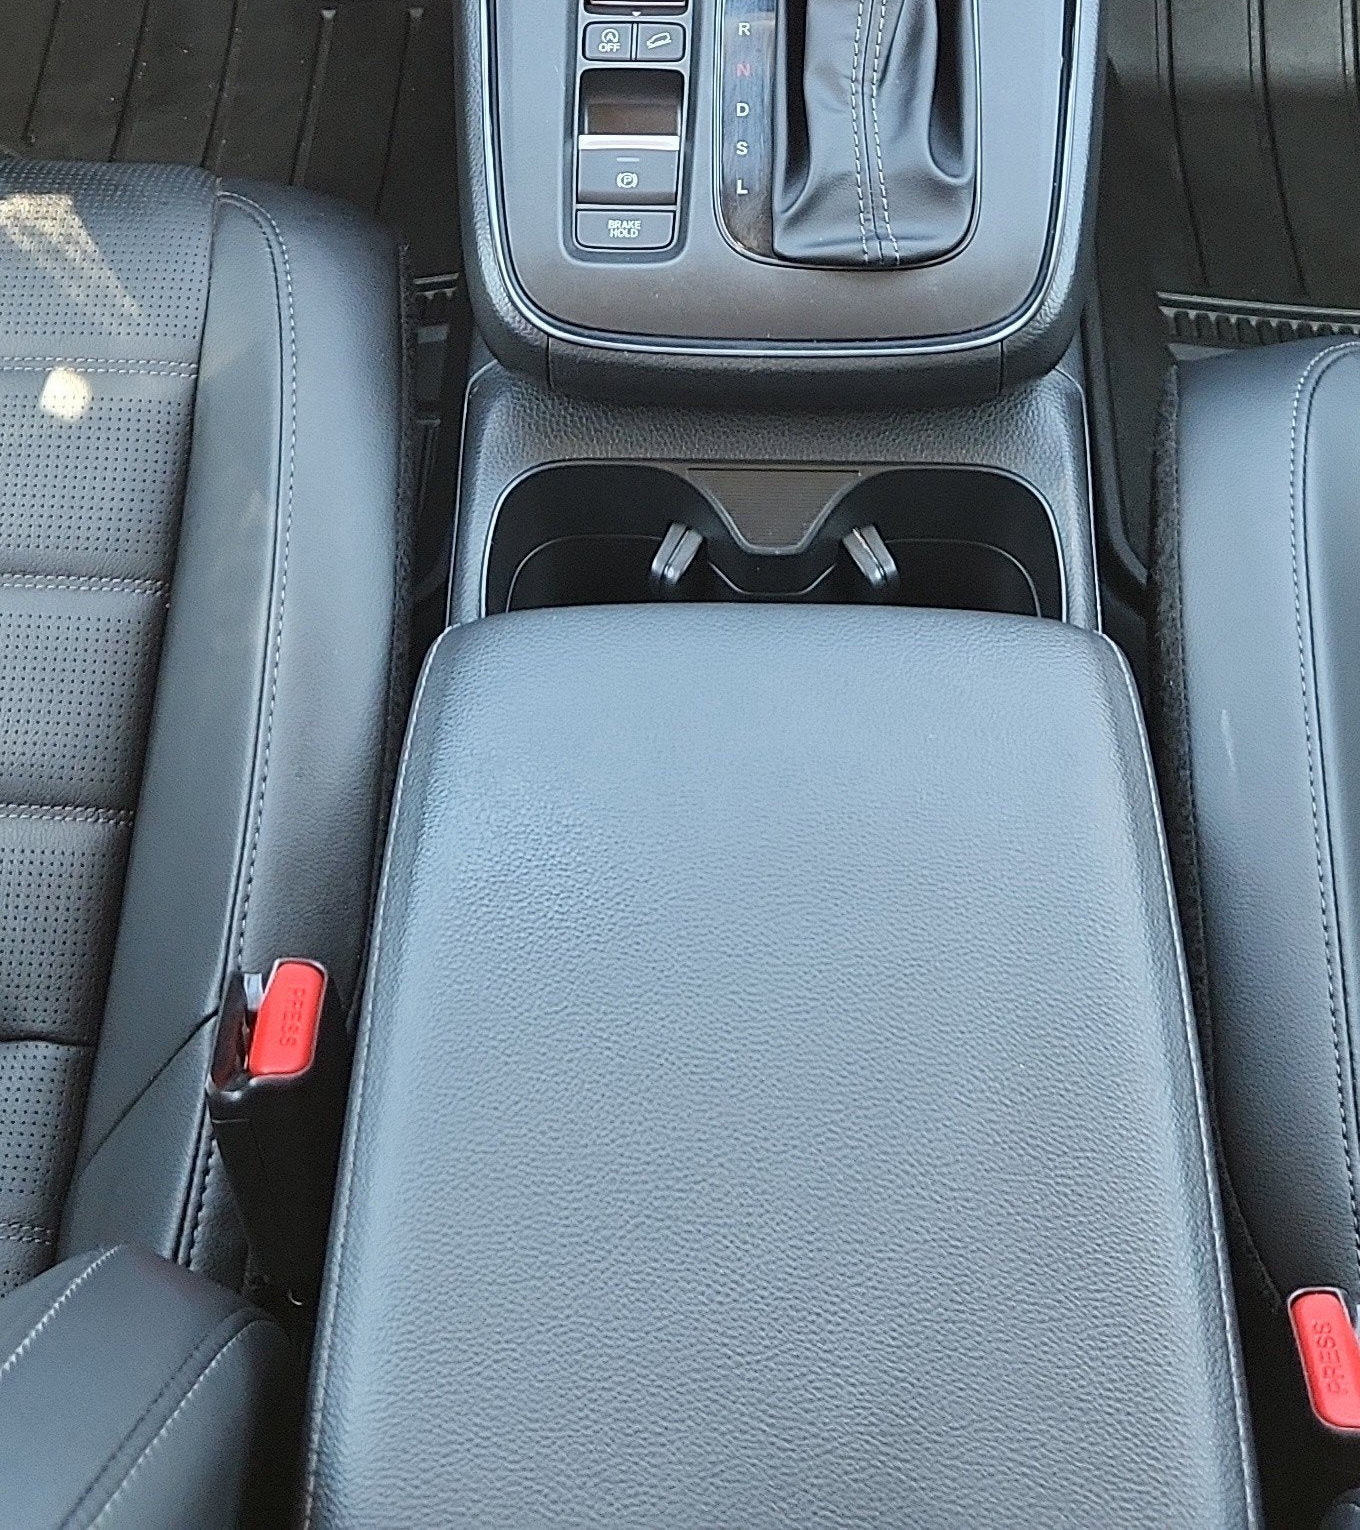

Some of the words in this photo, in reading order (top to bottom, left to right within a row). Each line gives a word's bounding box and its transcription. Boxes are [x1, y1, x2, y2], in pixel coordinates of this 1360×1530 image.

[738, 23, 750, 36] R
[599, 43, 621, 52] OFF
[736, 103, 749, 117] D
[736, 142, 748, 155] S
[736, 180, 748, 195] L
[608, 220, 641, 229] BRAKE
[609, 229, 638, 238] HOLD
